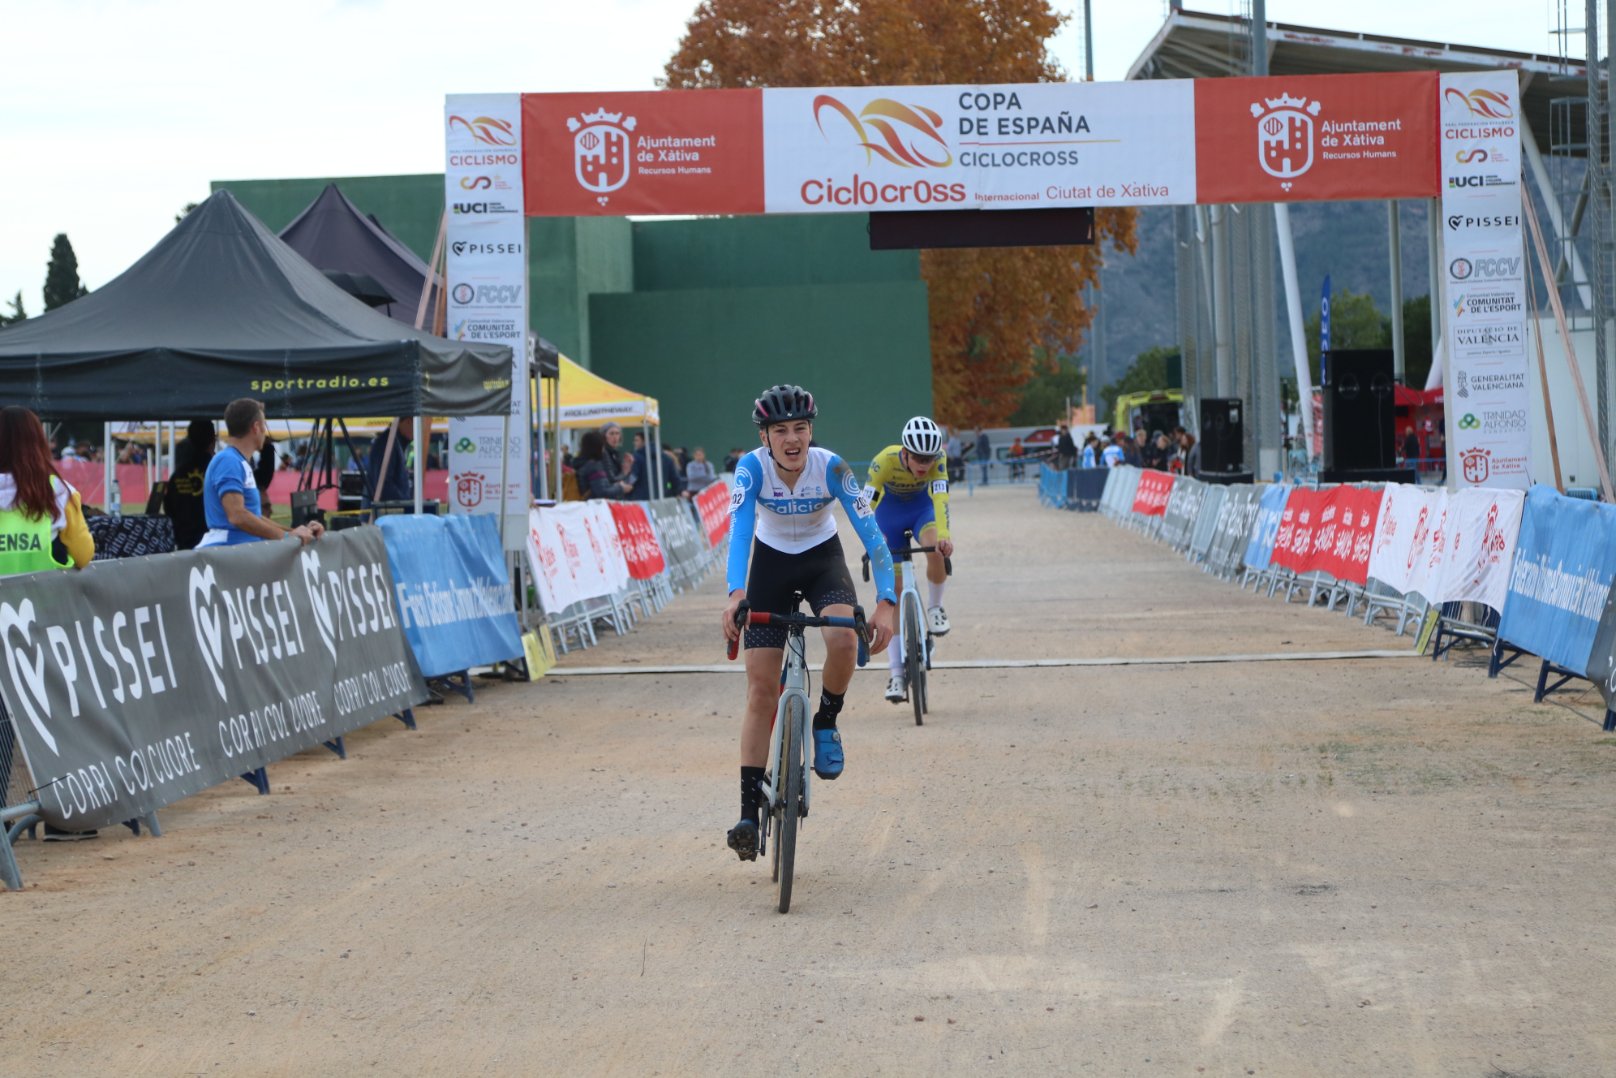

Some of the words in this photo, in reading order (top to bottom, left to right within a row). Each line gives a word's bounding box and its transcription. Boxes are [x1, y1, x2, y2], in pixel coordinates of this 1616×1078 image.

[959, 92, 1022, 111] COPA
[959, 117, 989, 135] DE
[998, 111, 1091, 135] ESPAÑA
[1321, 119, 1400, 135] Ajuntament
[1445, 127, 1514, 139] CICLISMO
[637, 135, 716, 148] Ajuntament
[1321, 138, 1338, 146] de
[1343, 133, 1384, 146] Xàtiva
[450, 154, 518, 166] CICLISMO
[637, 150, 654, 162] de
[658, 149, 700, 162] Xàtiva
[960, 151, 1078, 167] CICLOCROSS
[1322, 151, 1361, 159] Recursos
[1362, 150, 1397, 158] Humans
[638, 166, 677, 174] Recursos
[678, 165, 712, 174] Humans
[1455, 176, 1483, 187] UCI
[974, 191, 1040, 201] Internacional
[1046, 185, 1092, 200] Ciutat
[1096, 185, 1116, 199] de
[1120, 181, 1169, 198] Xàtiva
[460, 202, 488, 214] UCI
[1466, 216, 1518, 227] PISSEI
[469, 243, 522, 254] PISSEI
[1466, 296, 1515, 307] COMUNITAT
[1470, 306, 1480, 314] DE
[251, 375, 389, 392] sportradio.es
[1471, 373, 1525, 383] GENERALITAT
[1472, 381, 1524, 391] VALENCIANA
[222, 579, 305, 670] PISSEI
[46, 603, 177, 718] PISSEI
[52, 761, 117, 820] CORRI
[148, 731, 201, 784] CUORE
